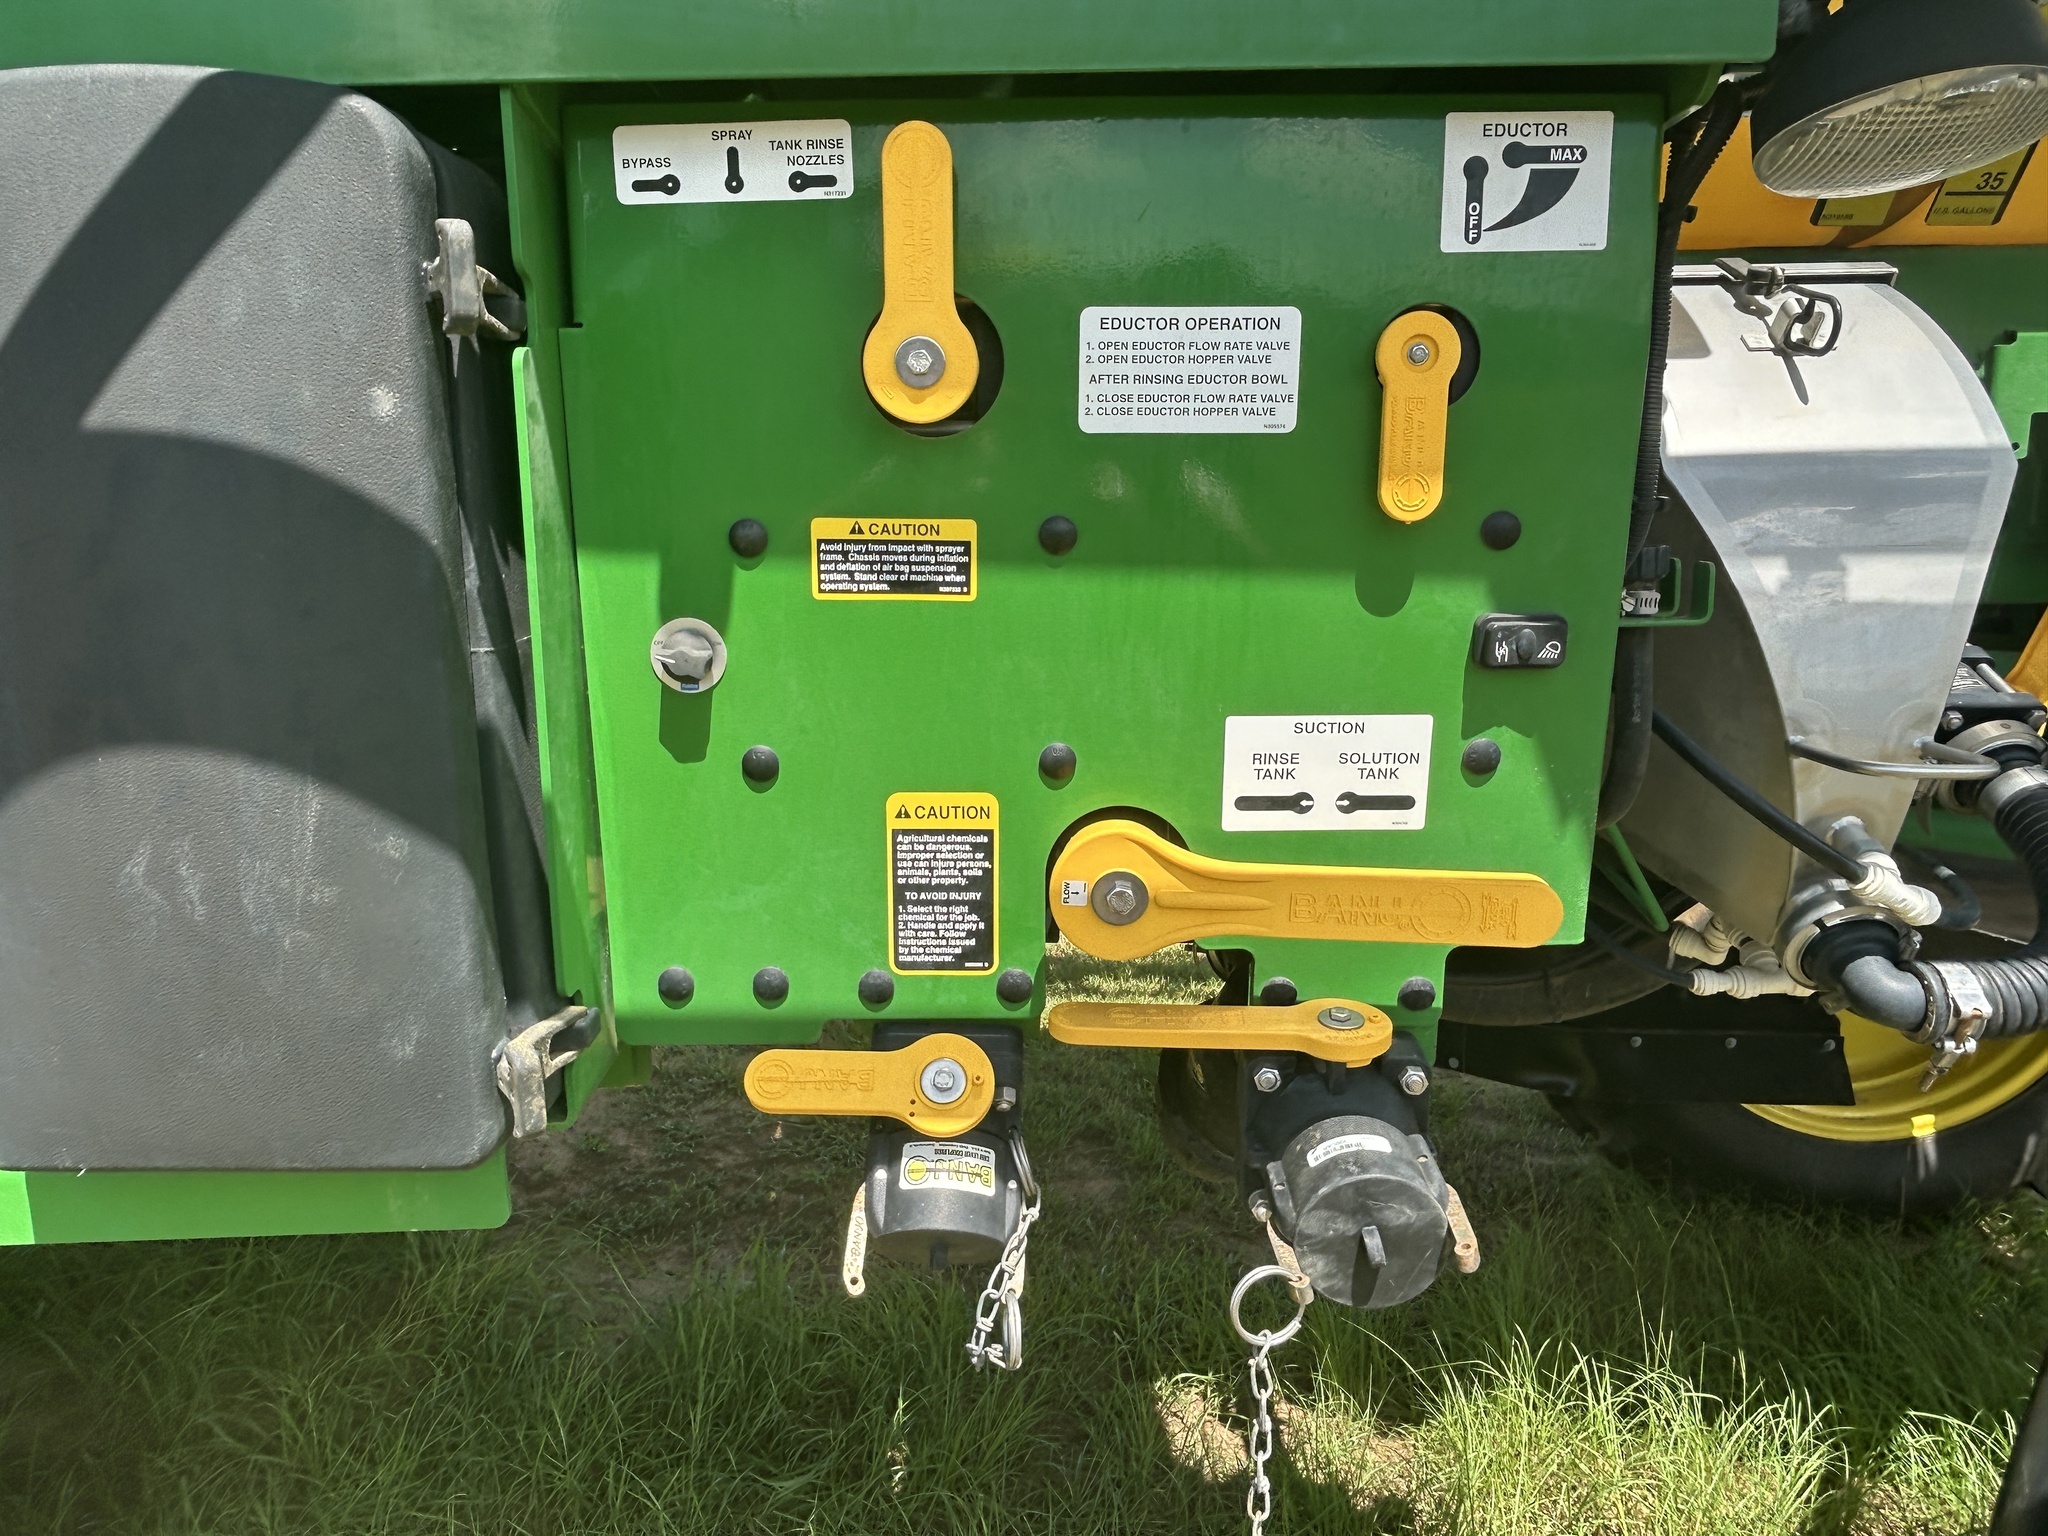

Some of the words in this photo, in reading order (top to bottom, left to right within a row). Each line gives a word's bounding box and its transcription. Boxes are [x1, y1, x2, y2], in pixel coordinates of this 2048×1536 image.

[1483, 123, 1568, 137] EDUCTOR
[712, 130, 752, 141] SPRAY
[769, 140, 802, 151] TANK
[807, 139, 844, 150] RINSE
[1550, 148, 1582, 161] MAX
[623, 158, 671, 168] BYPASS
[787, 155, 844, 166] NOZZLES
[1976, 172, 2007, 190] 35
[1469, 202, 1480, 241] OFF
[1100, 318, 1179, 330] EDUCTOR
[1185, 317, 1280, 330] OPERATION
[1087, 342, 1094, 350] 1.
[1098, 342, 1128, 350] OPEN
[1132, 342, 1185, 350] EDUCTOR
[1189, 342, 1220, 350] FLOW
[1224, 342, 1252, 350] RATE
[1256, 342, 1290, 350] VALVE
[1086, 356, 1094, 364] 2.
[1098, 355, 1128, 364] OPEN
[1132, 355, 1184, 364] EDUCTOR
[1189, 355, 1234, 364] HOPPER
[1237, 355, 1271, 364] VALVE
[1089, 375, 1129, 384] AFTER
[1133, 375, 1183, 384] RINSING
[1188, 375, 1247, 384] EDUCTOR
[1252, 375, 1288, 384] BOWL
[1097, 394, 1133, 403] CLOSE
[1138, 394, 1190, 403] EDUCTOR
[1194, 394, 1225, 403] FLOW
[1229, 394, 1257, 403] RATE
[1260, 394, 1294, 403] VALVE
[1085, 408, 1093, 416] 2.
[1097, 407, 1133, 416] CLOSE
[1137, 407, 1189, 416] EDUCTOR
[1194, 407, 1238, 416] HOPPER
[1242, 407, 1276, 416] VALVE
[869, 524, 940, 536] CAUTION
[844, 544, 866, 552] injury
[888, 544, 915, 552] impact
[917, 544, 933, 552] with
[910, 555, 935, 563] during
[895, 564, 909, 573] bag
[912, 565, 956, 573] suspension
[820, 583, 858, 591] operating
[1294, 722, 1364, 733] SUCTION
[1253, 753, 1299, 764] RINSE
[1339, 753, 1420, 764] SOLUTION
[1254, 769, 1296, 780] TANK
[1358, 768, 1399, 779] TANK
[915, 806, 990, 819] CAUTION
[897, 834, 945, 843] Agricultural
[914, 843, 924, 851] be
[926, 843, 972, 852] dangerous.
[898, 852, 934, 860] Improper
[931, 860, 954, 868] injure
[898, 868, 931, 876] animals,
[933, 868, 961, 877] plants,
[932, 877, 968, 885] property.
[905, 892, 918, 900] TO
[920, 892, 948, 900] AVOID
[950, 892, 982, 900] INJURY
[964, 913, 980, 922] job.
[955, 922, 977, 931] apply
[948, 938, 975, 946] issued
[904, 1156, 991, 1188] BANJO
